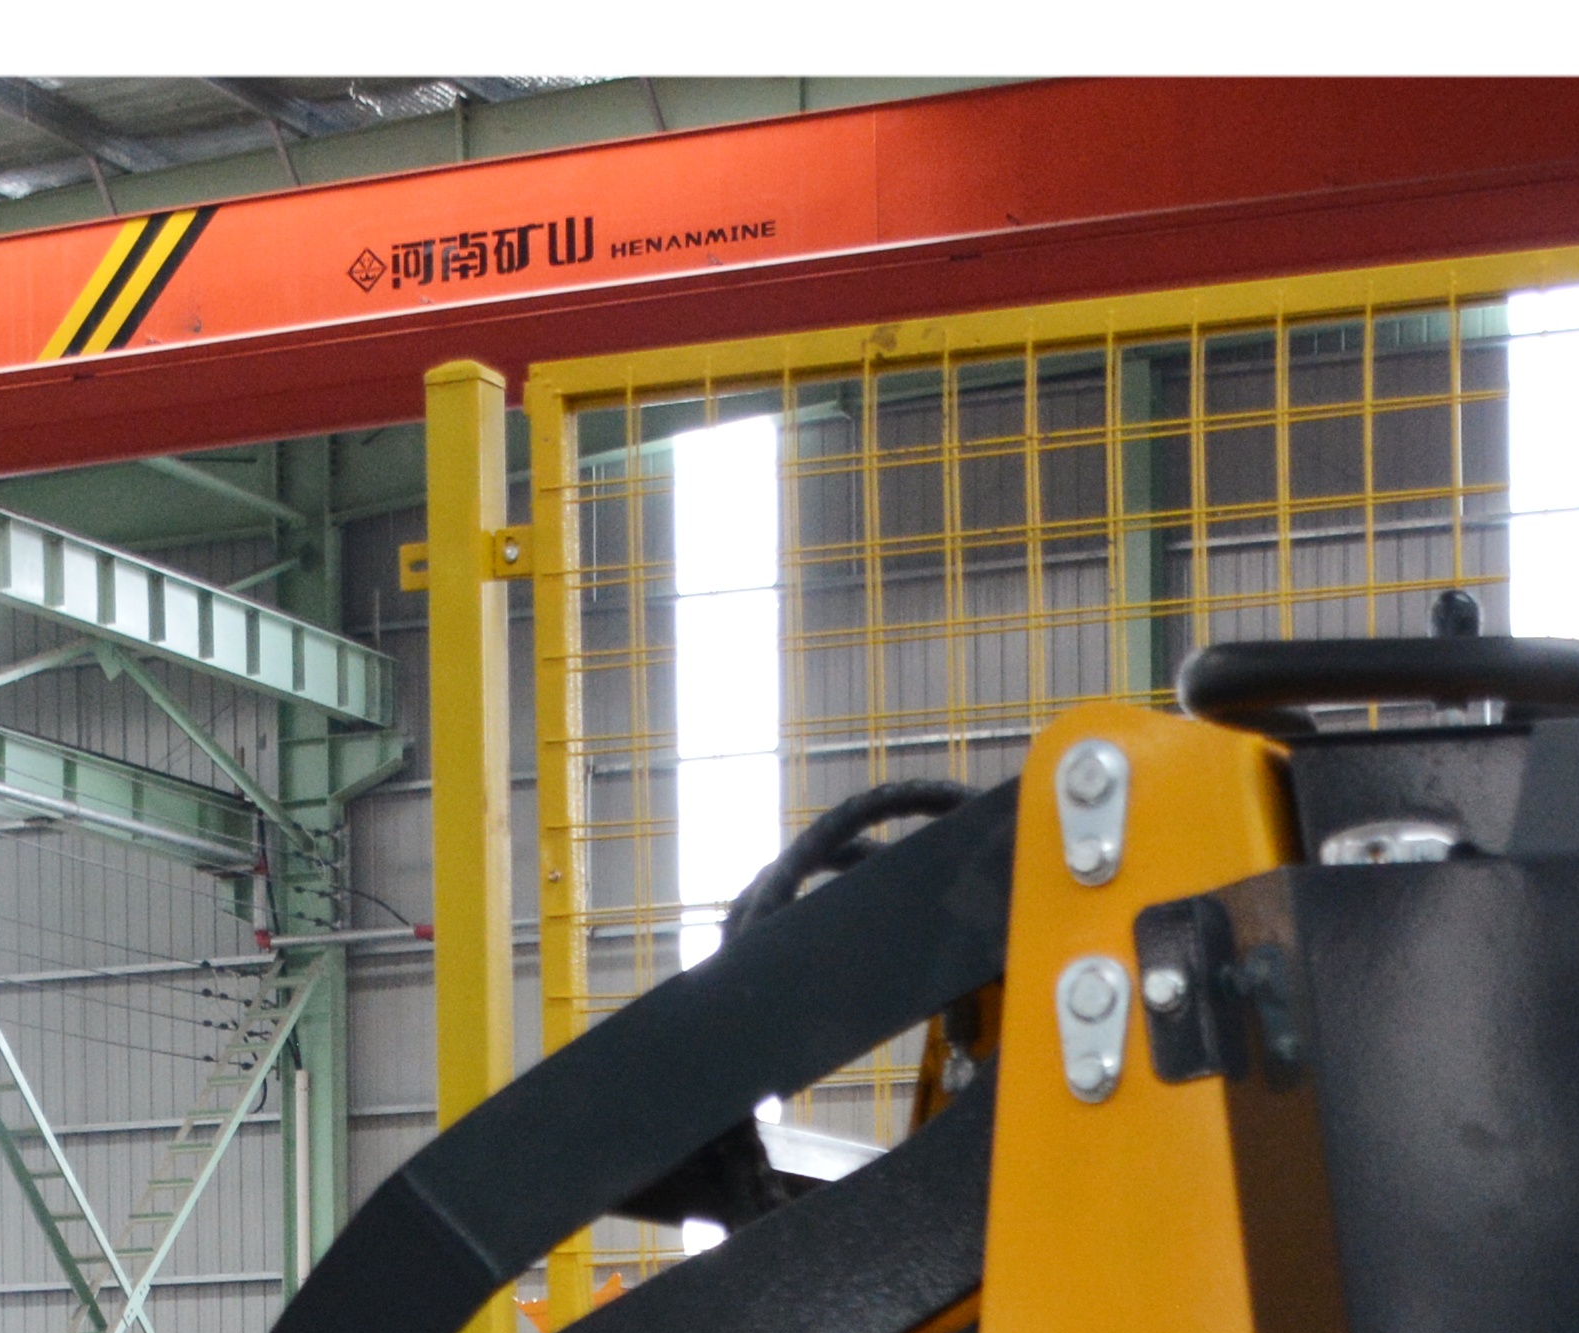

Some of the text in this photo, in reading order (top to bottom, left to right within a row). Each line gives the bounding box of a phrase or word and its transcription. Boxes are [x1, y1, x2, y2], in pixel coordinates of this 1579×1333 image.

[391, 216, 594, 290] 河南矿山
[611, 220, 776, 259] HENANMINE
